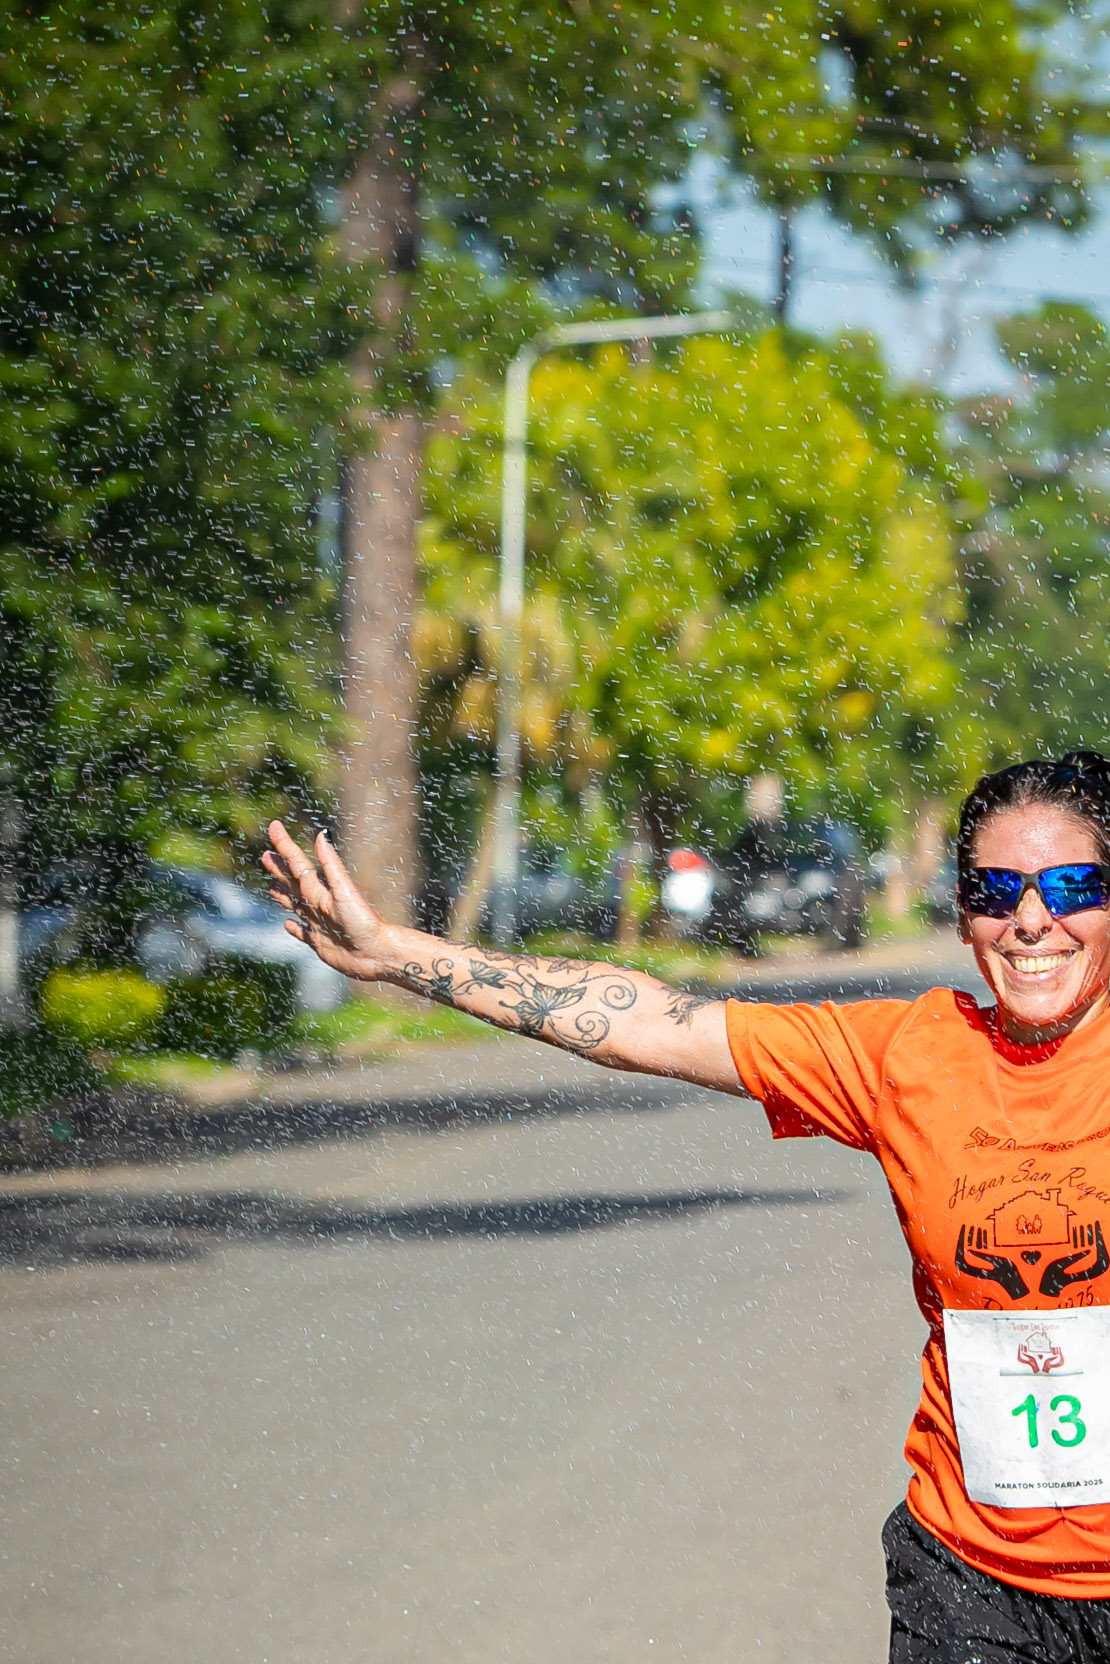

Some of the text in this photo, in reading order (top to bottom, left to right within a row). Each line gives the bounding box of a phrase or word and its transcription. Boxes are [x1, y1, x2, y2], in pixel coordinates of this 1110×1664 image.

[949, 1174, 1004, 1209] Hogar
[1012, 1158, 1052, 1184] San
[1012, 1394, 1087, 1448] 13
[995, 1478, 1104, 1490] MARATON SOLIDARIA 2025
